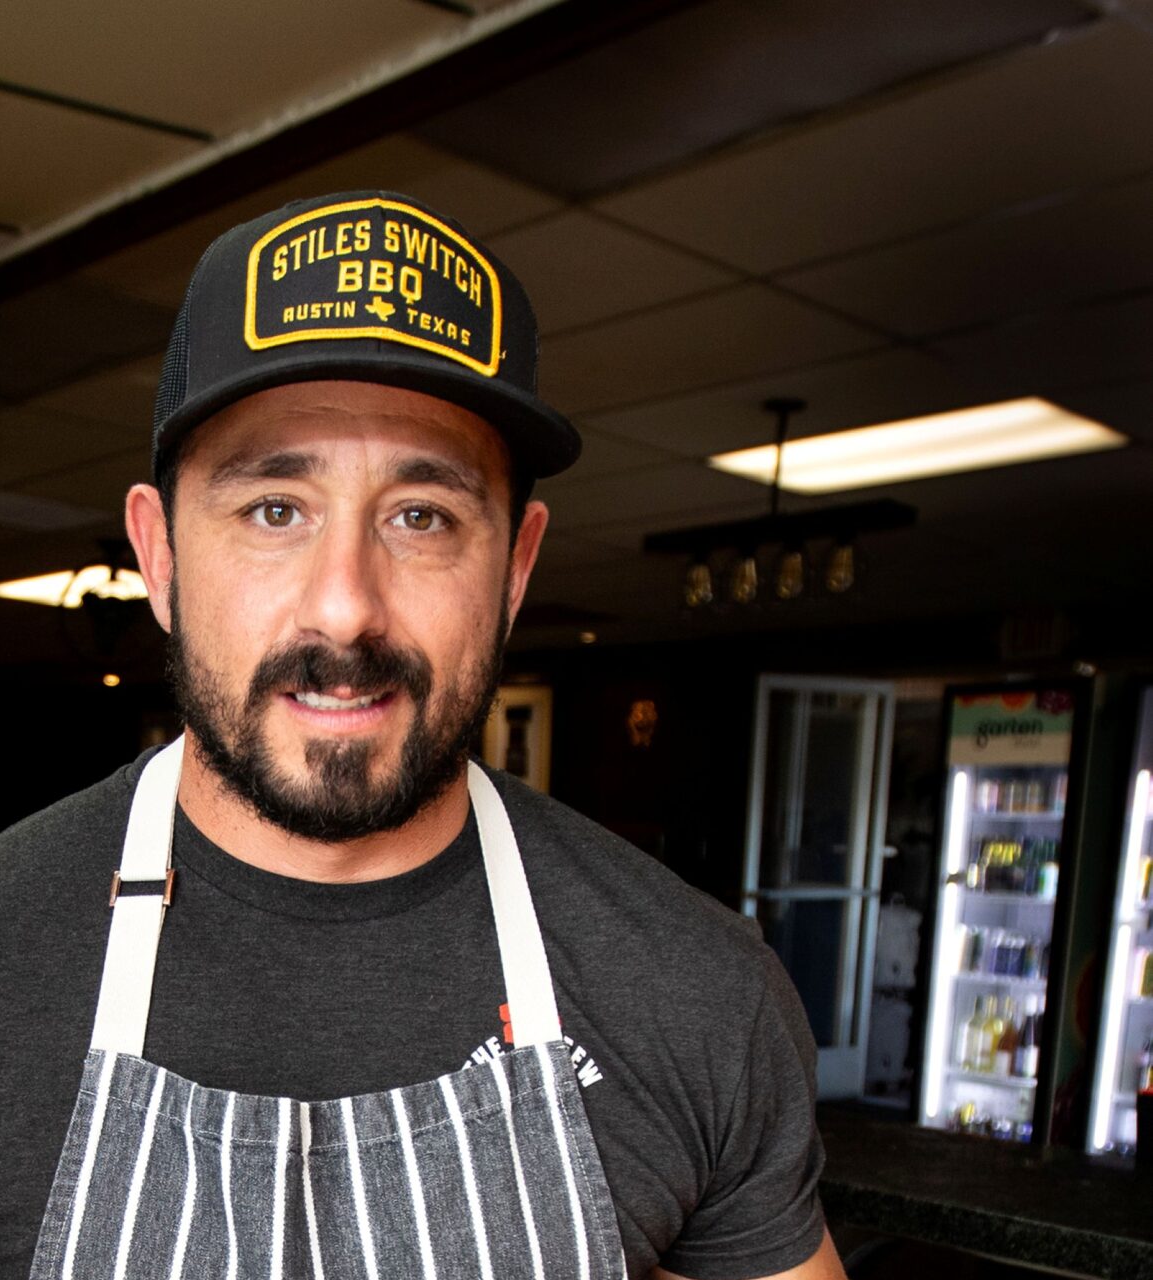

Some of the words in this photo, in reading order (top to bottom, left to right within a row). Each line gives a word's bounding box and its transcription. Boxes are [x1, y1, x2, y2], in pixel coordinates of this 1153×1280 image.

[272, 219, 371, 281] STILES
[384, 221, 483, 308] SWITCH
[336, 259, 423, 304] BBQ
[283, 300, 356, 323] AUSTIN
[407, 308, 472, 347] TEXAS
[461, 1035, 506, 1071] HE
[563, 1035, 604, 1088] EW
